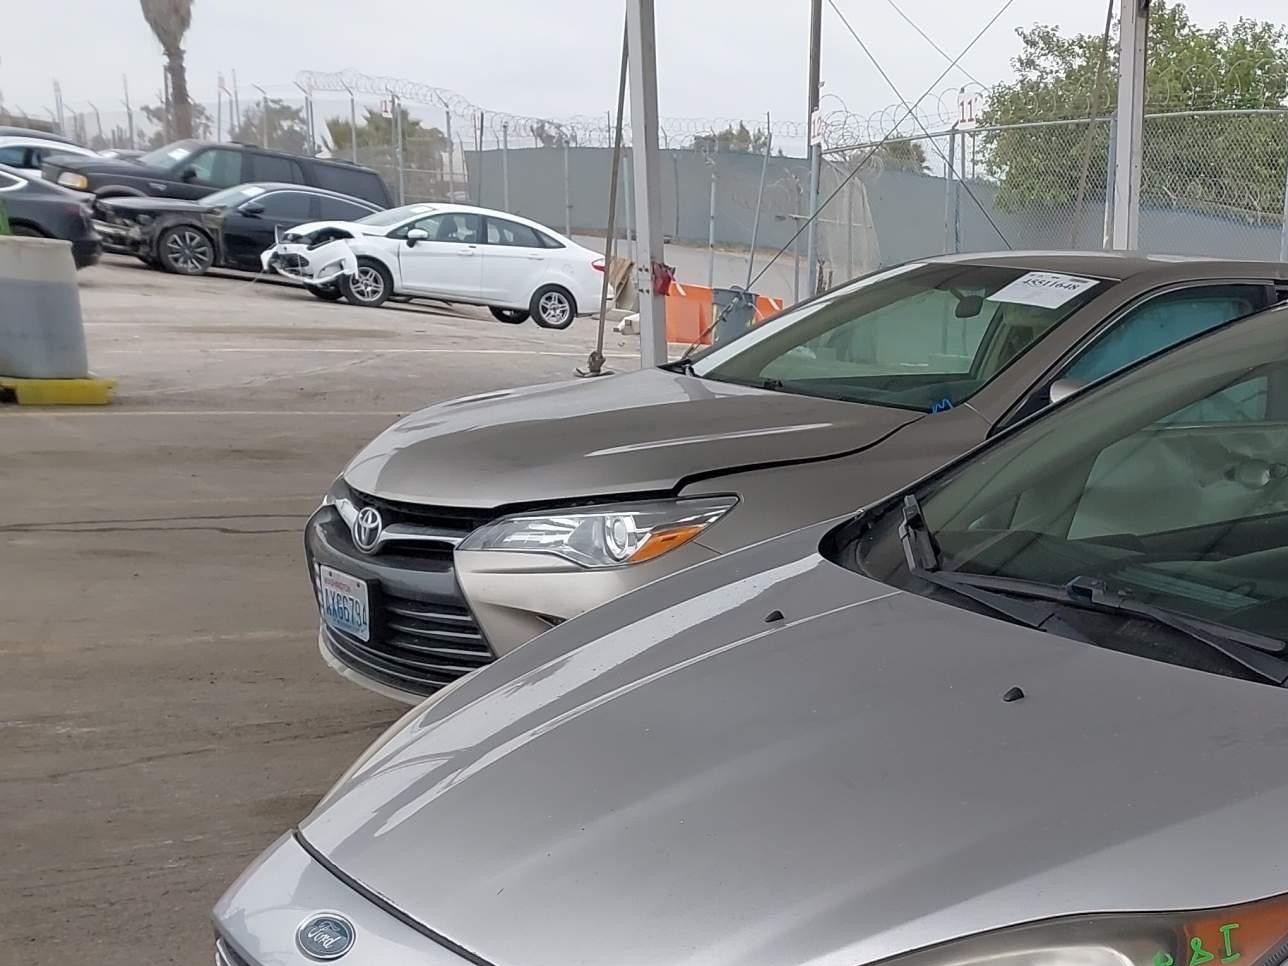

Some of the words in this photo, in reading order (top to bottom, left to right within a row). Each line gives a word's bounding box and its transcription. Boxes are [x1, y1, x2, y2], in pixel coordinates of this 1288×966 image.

[959, 100, 975, 123] 11
[307, 920, 342, 949] Ford
[1220, 923, 1241, 964] I
